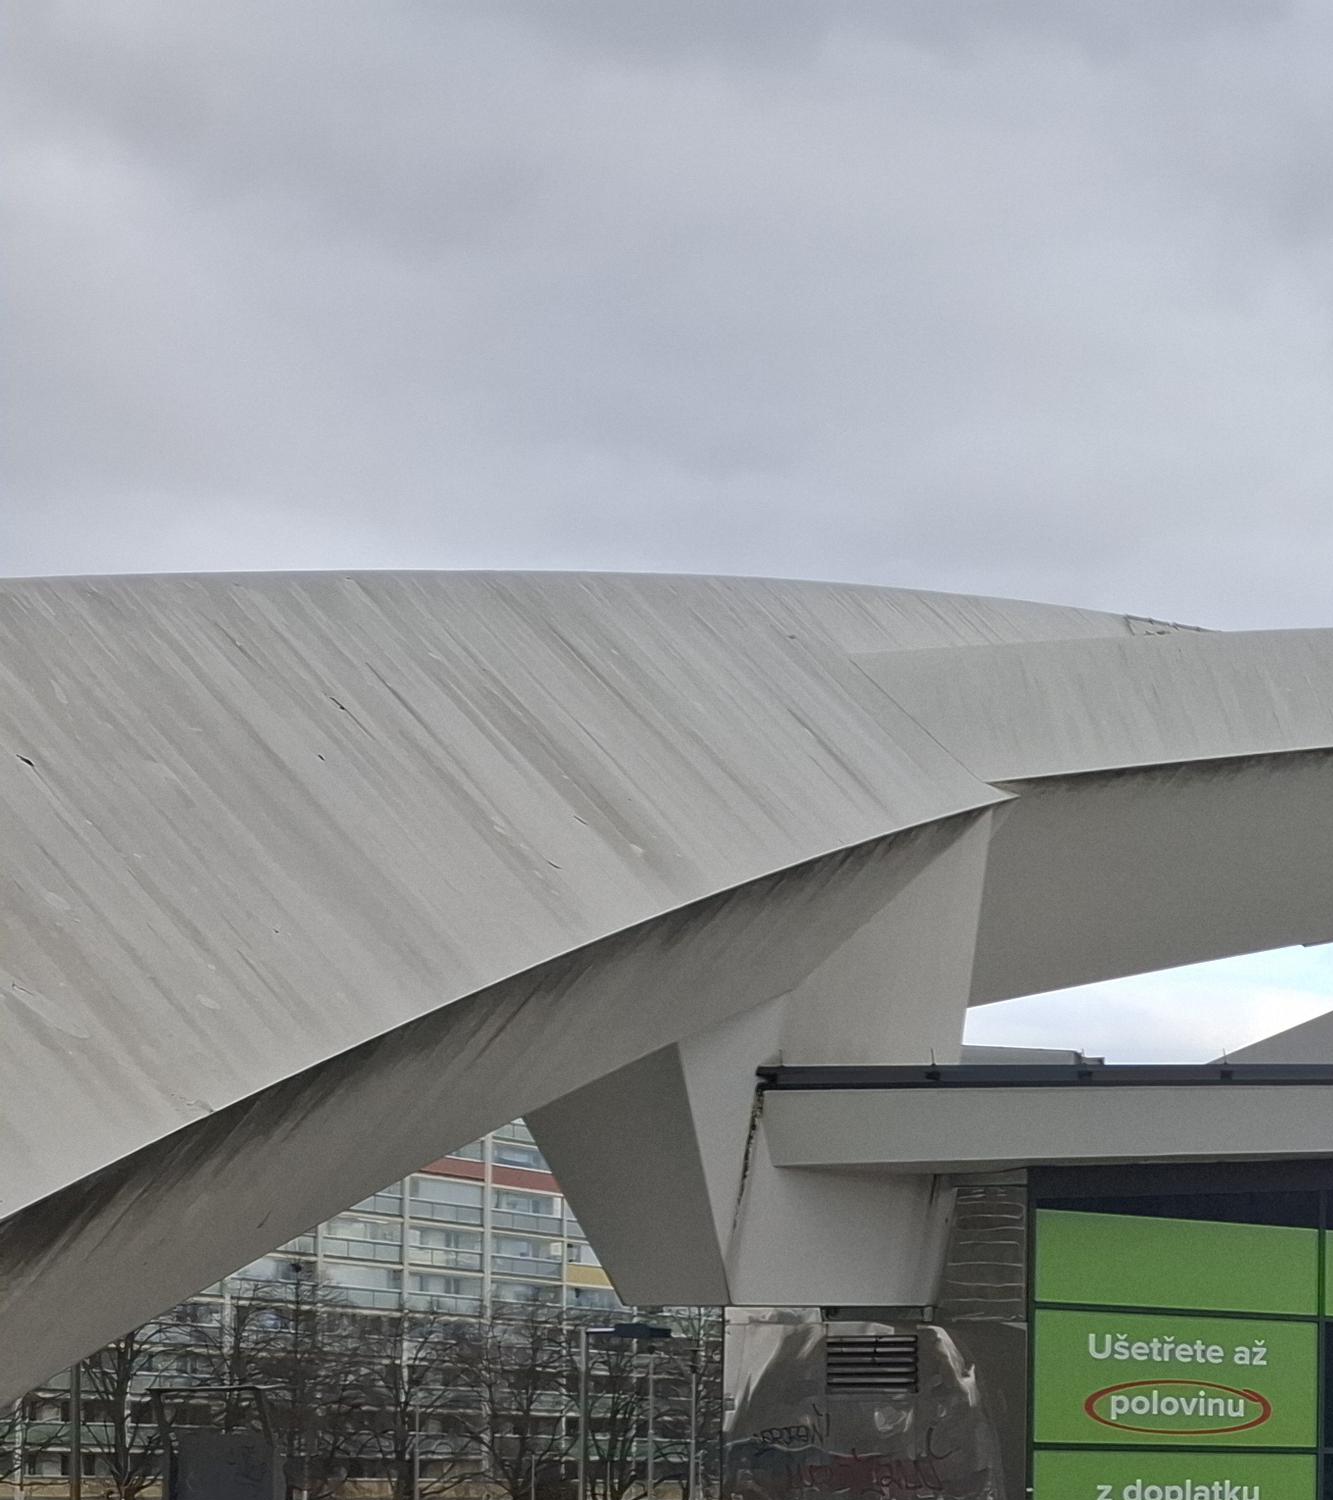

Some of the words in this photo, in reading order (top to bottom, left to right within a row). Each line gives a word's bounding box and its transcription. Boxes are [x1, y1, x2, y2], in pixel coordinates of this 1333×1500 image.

[1088, 1333, 1224, 1364] Ušetřete
[1233, 1339, 1268, 1366] až
[1110, 1390, 1245, 1420] polovinu
